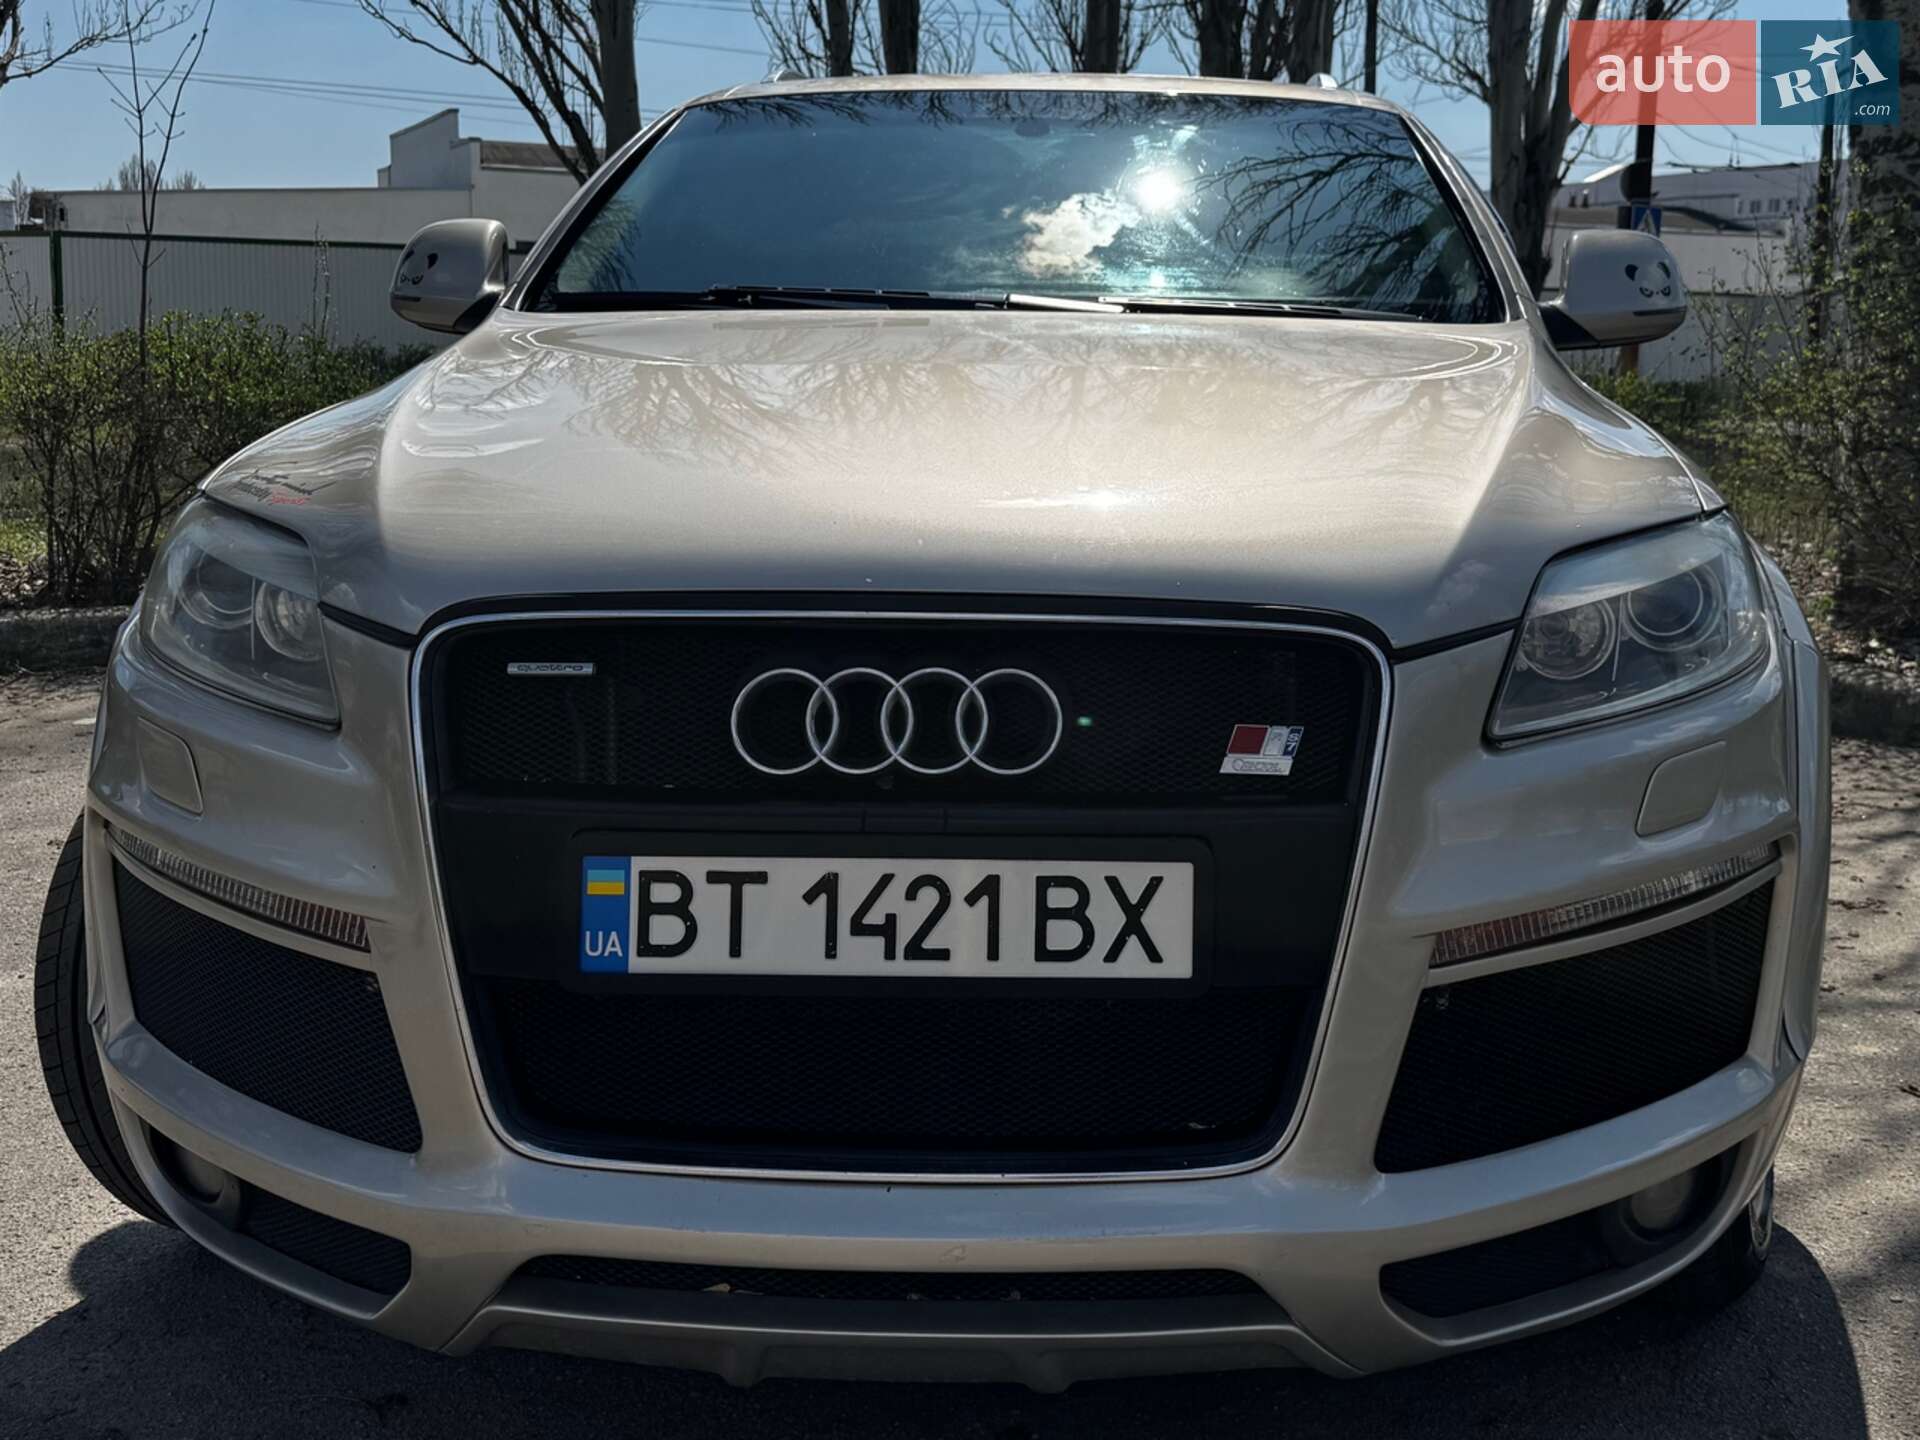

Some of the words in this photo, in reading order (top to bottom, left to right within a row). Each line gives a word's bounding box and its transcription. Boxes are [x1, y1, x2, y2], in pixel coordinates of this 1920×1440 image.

[585, 931, 623, 957] UA
[636, 869, 769, 958] BT
[801, 871, 1001, 962] 1421
[1034, 874, 1165, 964] BX
